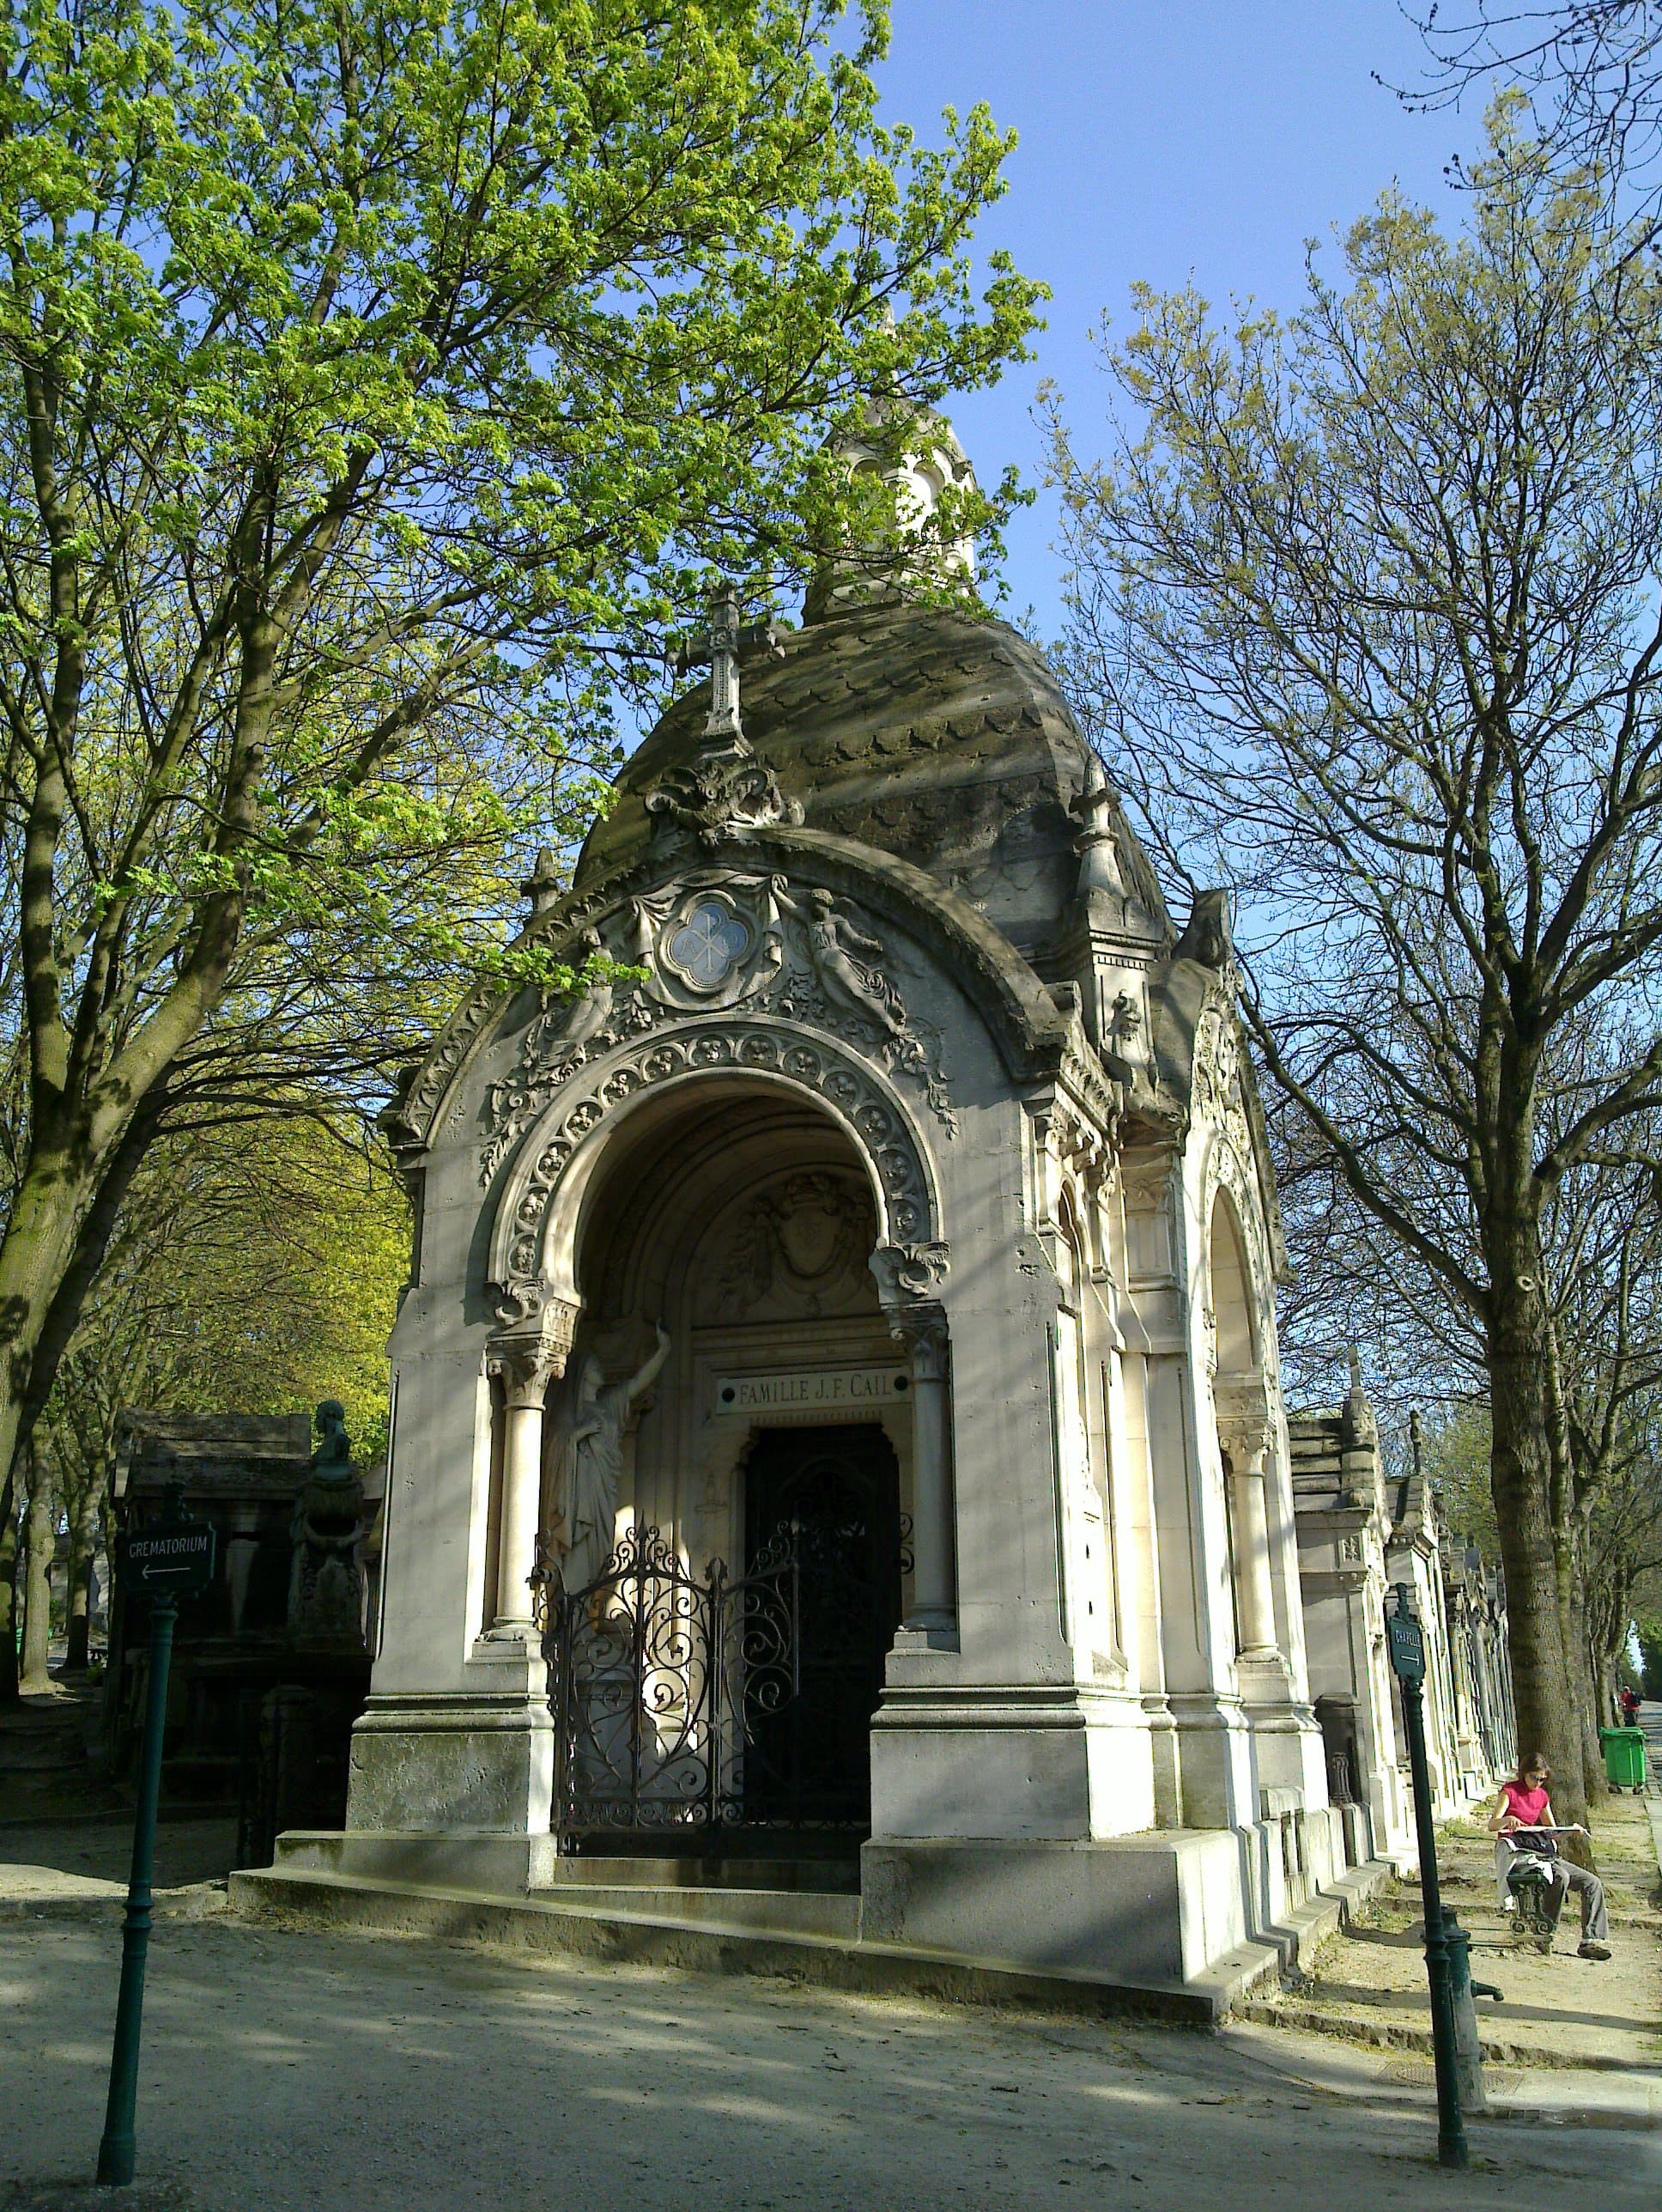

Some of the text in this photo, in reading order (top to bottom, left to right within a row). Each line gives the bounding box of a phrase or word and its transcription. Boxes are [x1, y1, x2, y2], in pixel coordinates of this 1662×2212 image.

[740, 1380, 809, 1404] FAMILLE
[851, 1374, 892, 1397] CAIL
[129, 1536, 207, 1559] CREMATORIUM
